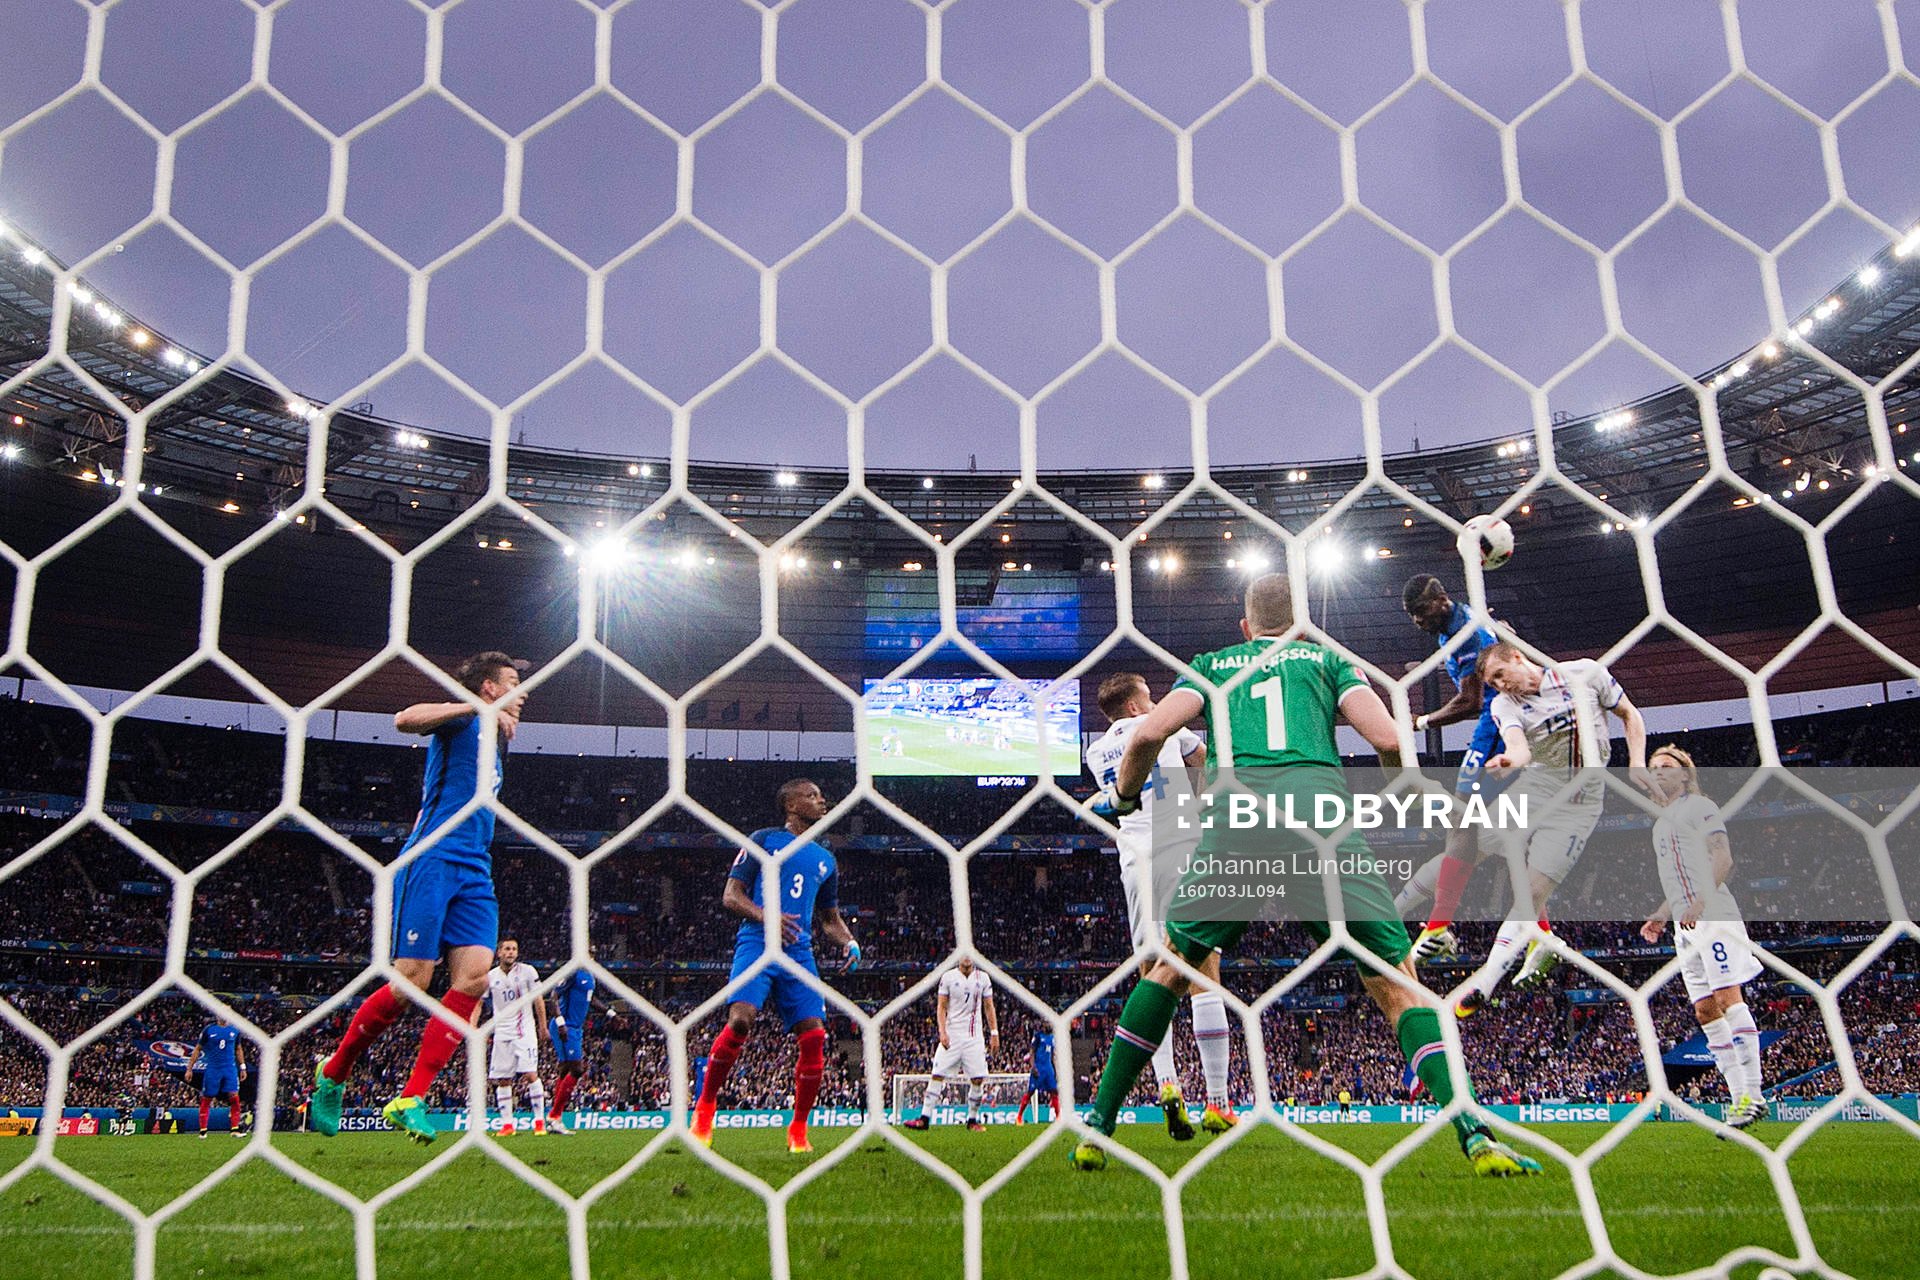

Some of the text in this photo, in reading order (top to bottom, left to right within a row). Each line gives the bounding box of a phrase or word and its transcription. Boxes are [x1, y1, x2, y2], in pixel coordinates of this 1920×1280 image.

[1250, 676, 1287, 752] 1
[789, 873, 804, 899] 3
[1711, 941, 1728, 963] 8
[501, 988, 516, 1002] 10
[338, 1115, 395, 1131] RESPEC
[574, 1112, 665, 1130] Hisense
[1519, 1104, 1610, 1123] Hisense
